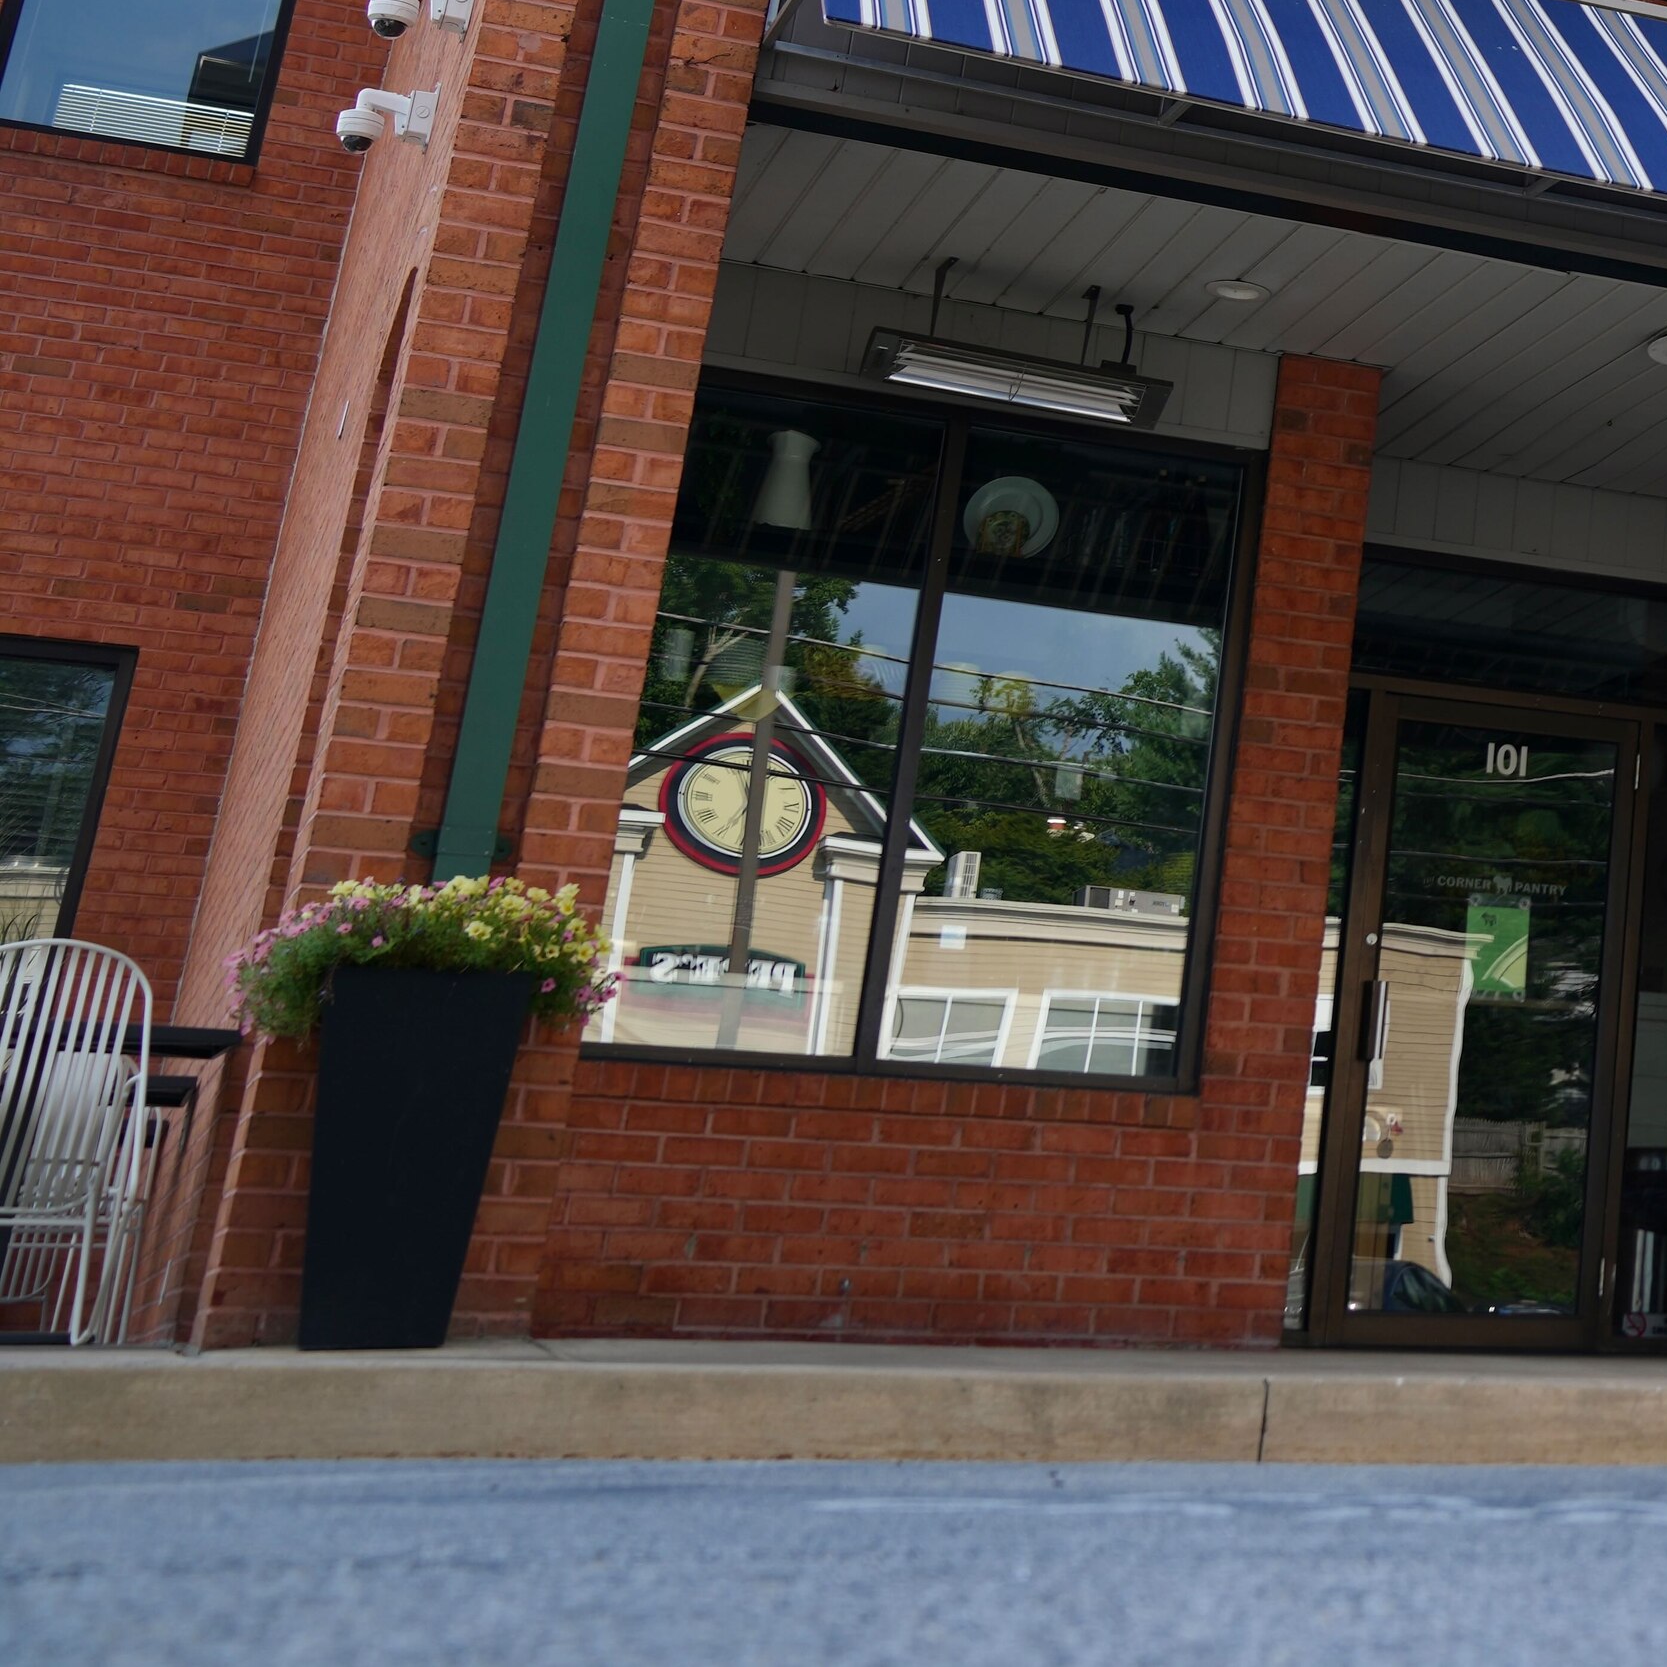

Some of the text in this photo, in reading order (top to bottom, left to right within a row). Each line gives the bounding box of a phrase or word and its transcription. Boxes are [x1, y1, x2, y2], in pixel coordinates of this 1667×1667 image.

[1485, 742, 1529, 777] 101
[1436, 875, 1491, 891] CORNER
[1515, 882, 1568, 897] PANTRY
